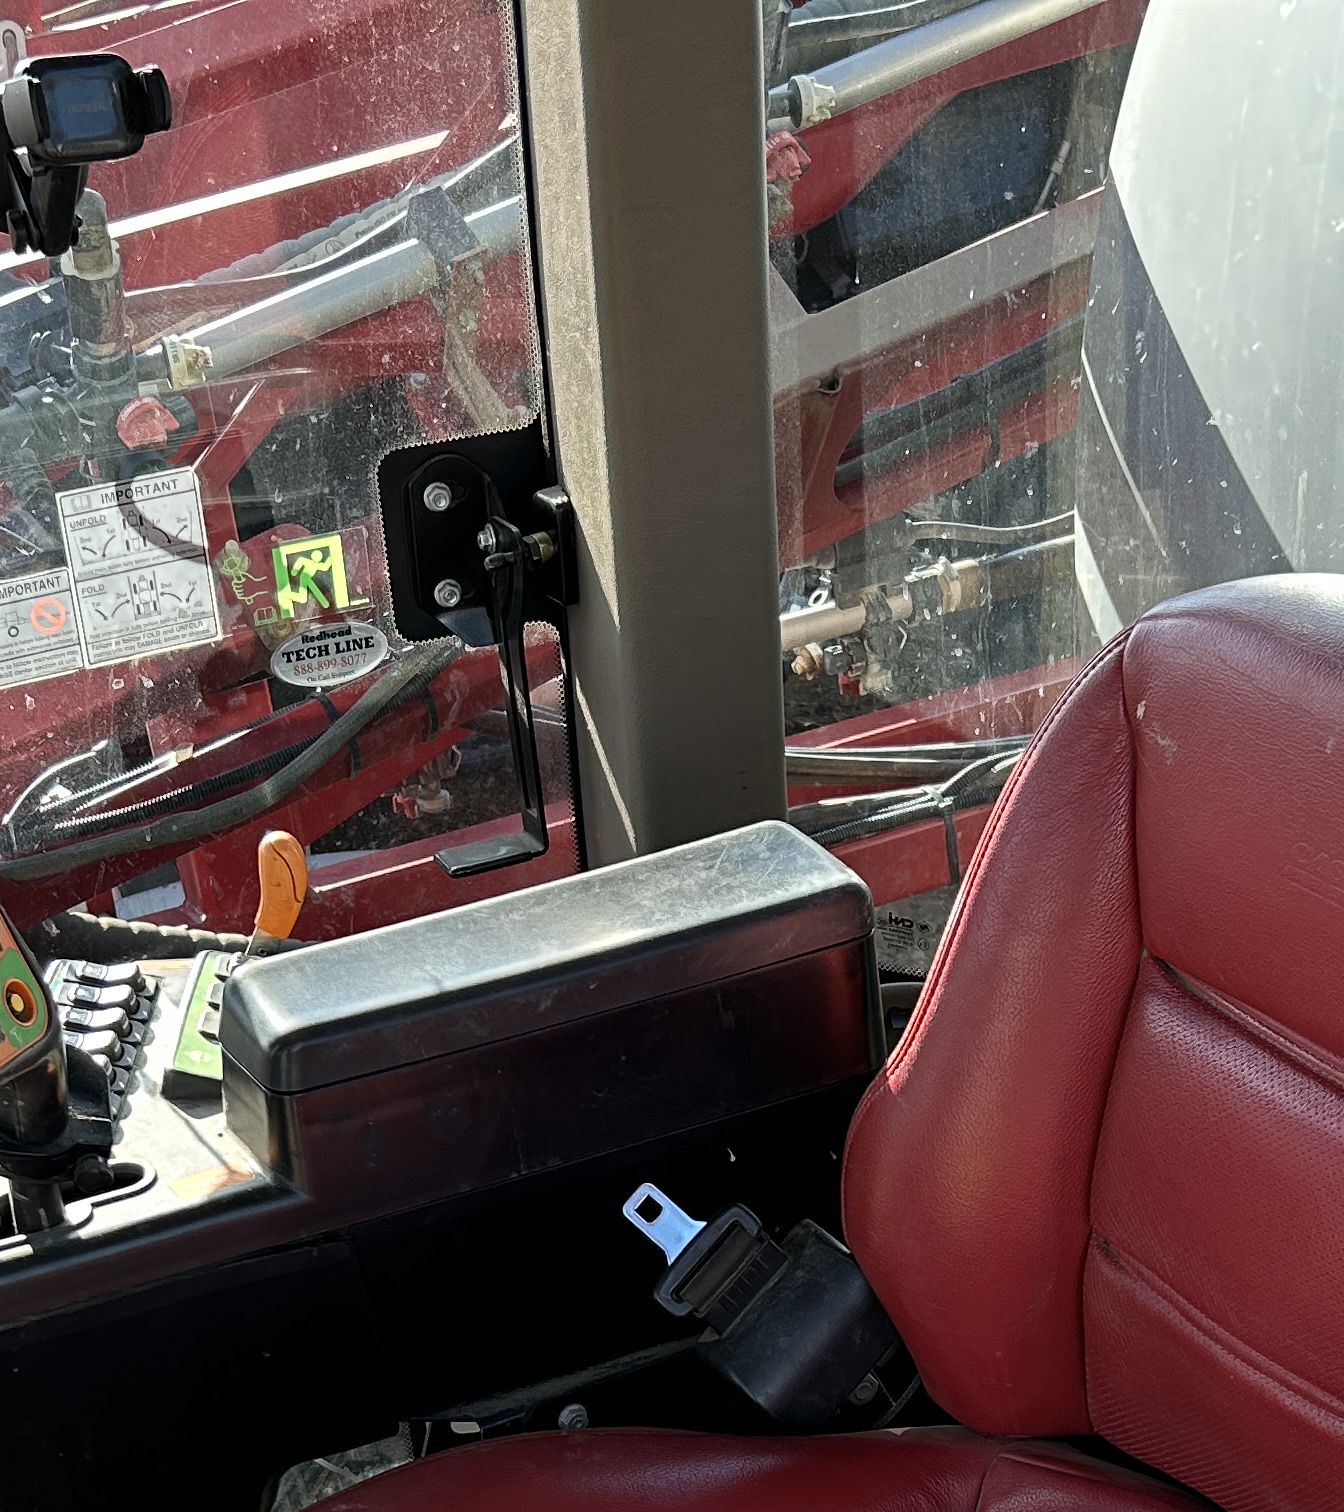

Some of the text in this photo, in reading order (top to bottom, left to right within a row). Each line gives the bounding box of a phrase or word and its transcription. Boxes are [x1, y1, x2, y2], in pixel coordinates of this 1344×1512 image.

[100, 478, 178, 504] IMPORTANT
[69, 514, 106, 529] UNFOLD
[81, 583, 105, 596] FOLD
[301, 624, 352, 644] Redhead
[281, 635, 375, 664] TECH LINE
[293, 652, 367, 677] 888-899-8077
[317, 672, 330, 682] Call
